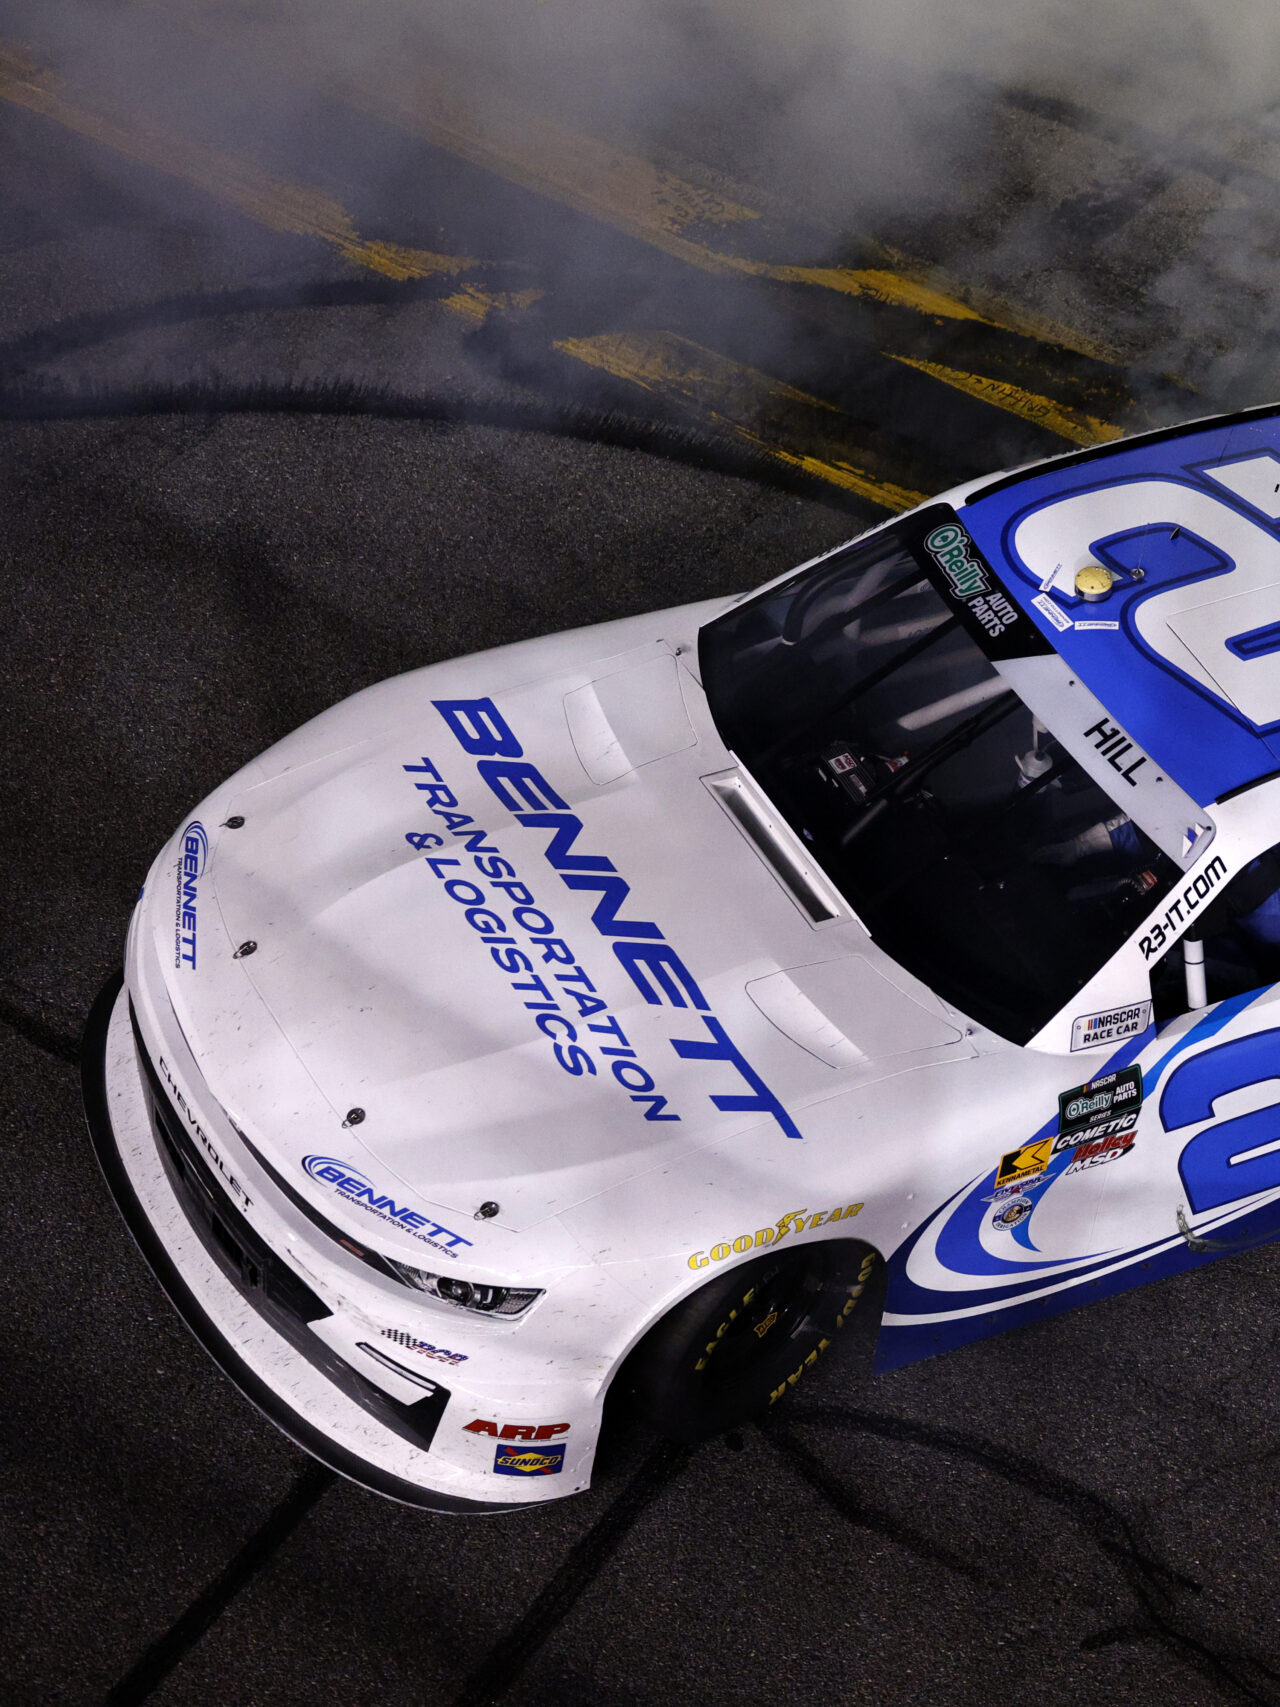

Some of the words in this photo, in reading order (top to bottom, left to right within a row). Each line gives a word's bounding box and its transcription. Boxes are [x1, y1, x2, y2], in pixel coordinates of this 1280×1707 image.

[926, 523, 988, 597] O'Reilly
[985, 591, 1018, 626] AUTO
[967, 595, 1006, 638] PARTS
[1083, 717, 1147, 787] HILL
[181, 835, 198, 970] BENNETT
[430, 697, 803, 1139] BENNETT
[1138, 855, 1228, 959] R3-IT.COM
[402, 757, 682, 1122] TRANSPORTATION
[405, 831, 444, 852] &
[426, 857, 598, 1077] LOGISTICS
[1083, 1028, 1114, 1044] RACE
[1116, 1021, 1139, 1035] CAR
[1097, 1007, 1141, 1029] NASCAR
[1067, 1091, 1112, 1119] O'Reilly
[1115, 1081, 1135, 1095] AUTO
[1091, 1073, 1117, 1090] NASCAR
[1113, 1089, 1137, 1104] PARTS
[159, 1056, 255, 1212] CHEVROLET
[1056, 1113, 1137, 1150] COMETIC
[1089, 1109, 1112, 1123] SERIES
[1065, 1148, 1127, 1176] MSD
[1071, 1130, 1138, 1162] Holley
[996, 1165, 1045, 1187] KENNAMETAL
[314, 1164, 474, 1248] BENNETT
[334, 1187, 407, 1231] TRANSPORTATION
[411, 1230, 459, 1259] LOGISTICS
[687, 1202, 865, 1270] GOODYEAR
[462, 1419, 571, 1440] ARP
[499, 1455, 560, 1467] SUNOCO
